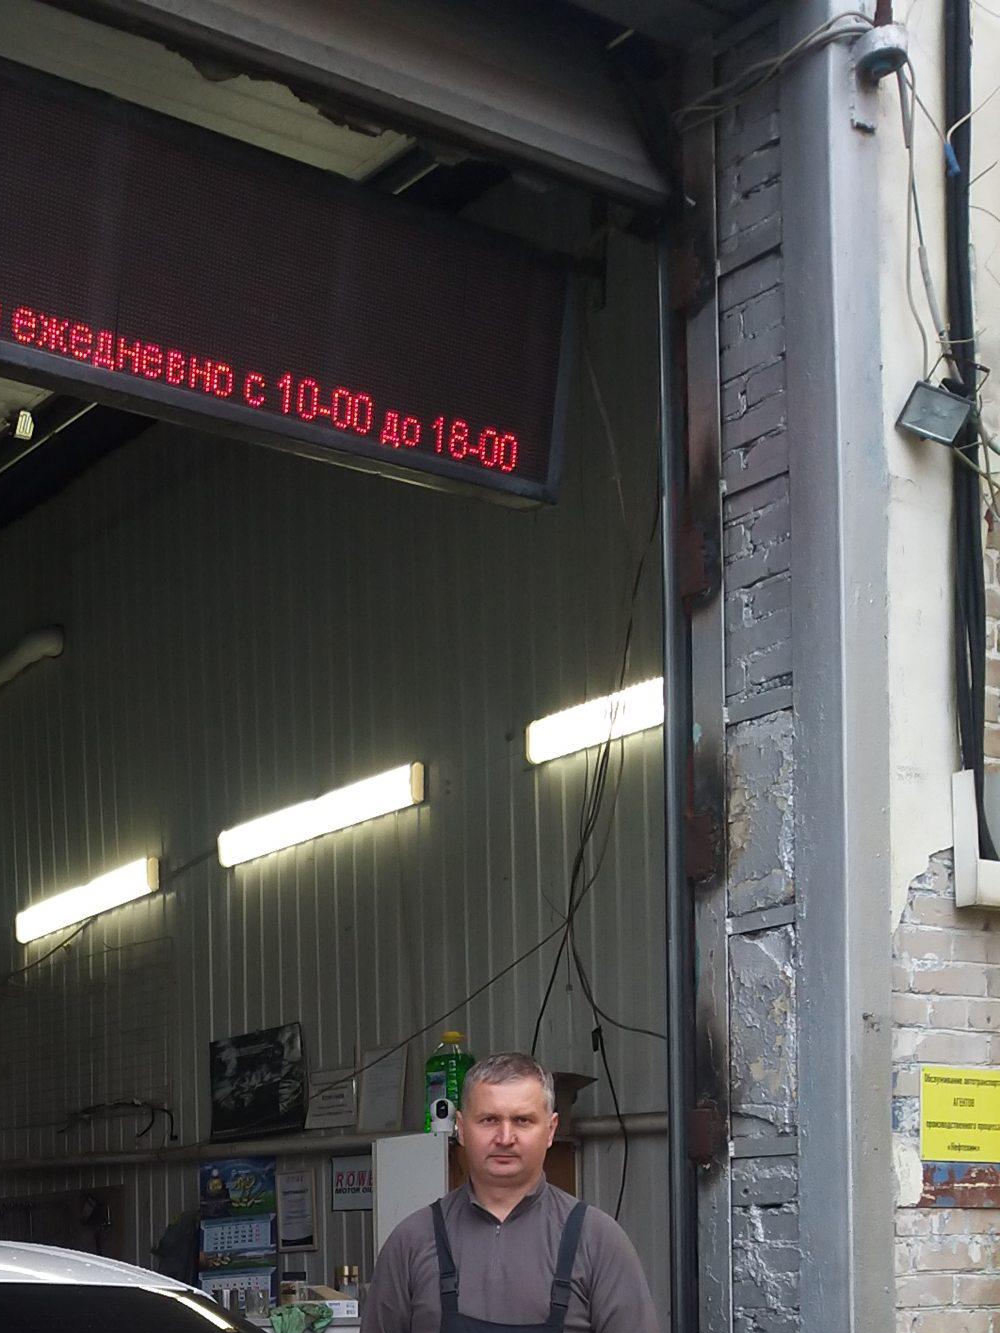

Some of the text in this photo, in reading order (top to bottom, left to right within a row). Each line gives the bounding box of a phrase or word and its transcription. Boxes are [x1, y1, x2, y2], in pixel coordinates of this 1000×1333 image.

[11, 306, 234, 397] ежедневно
[243, 371, 266, 407] с
[276, 372, 373, 436] 10-00
[379, 410, 421, 449] до
[432, 416, 518, 472] 18-00
